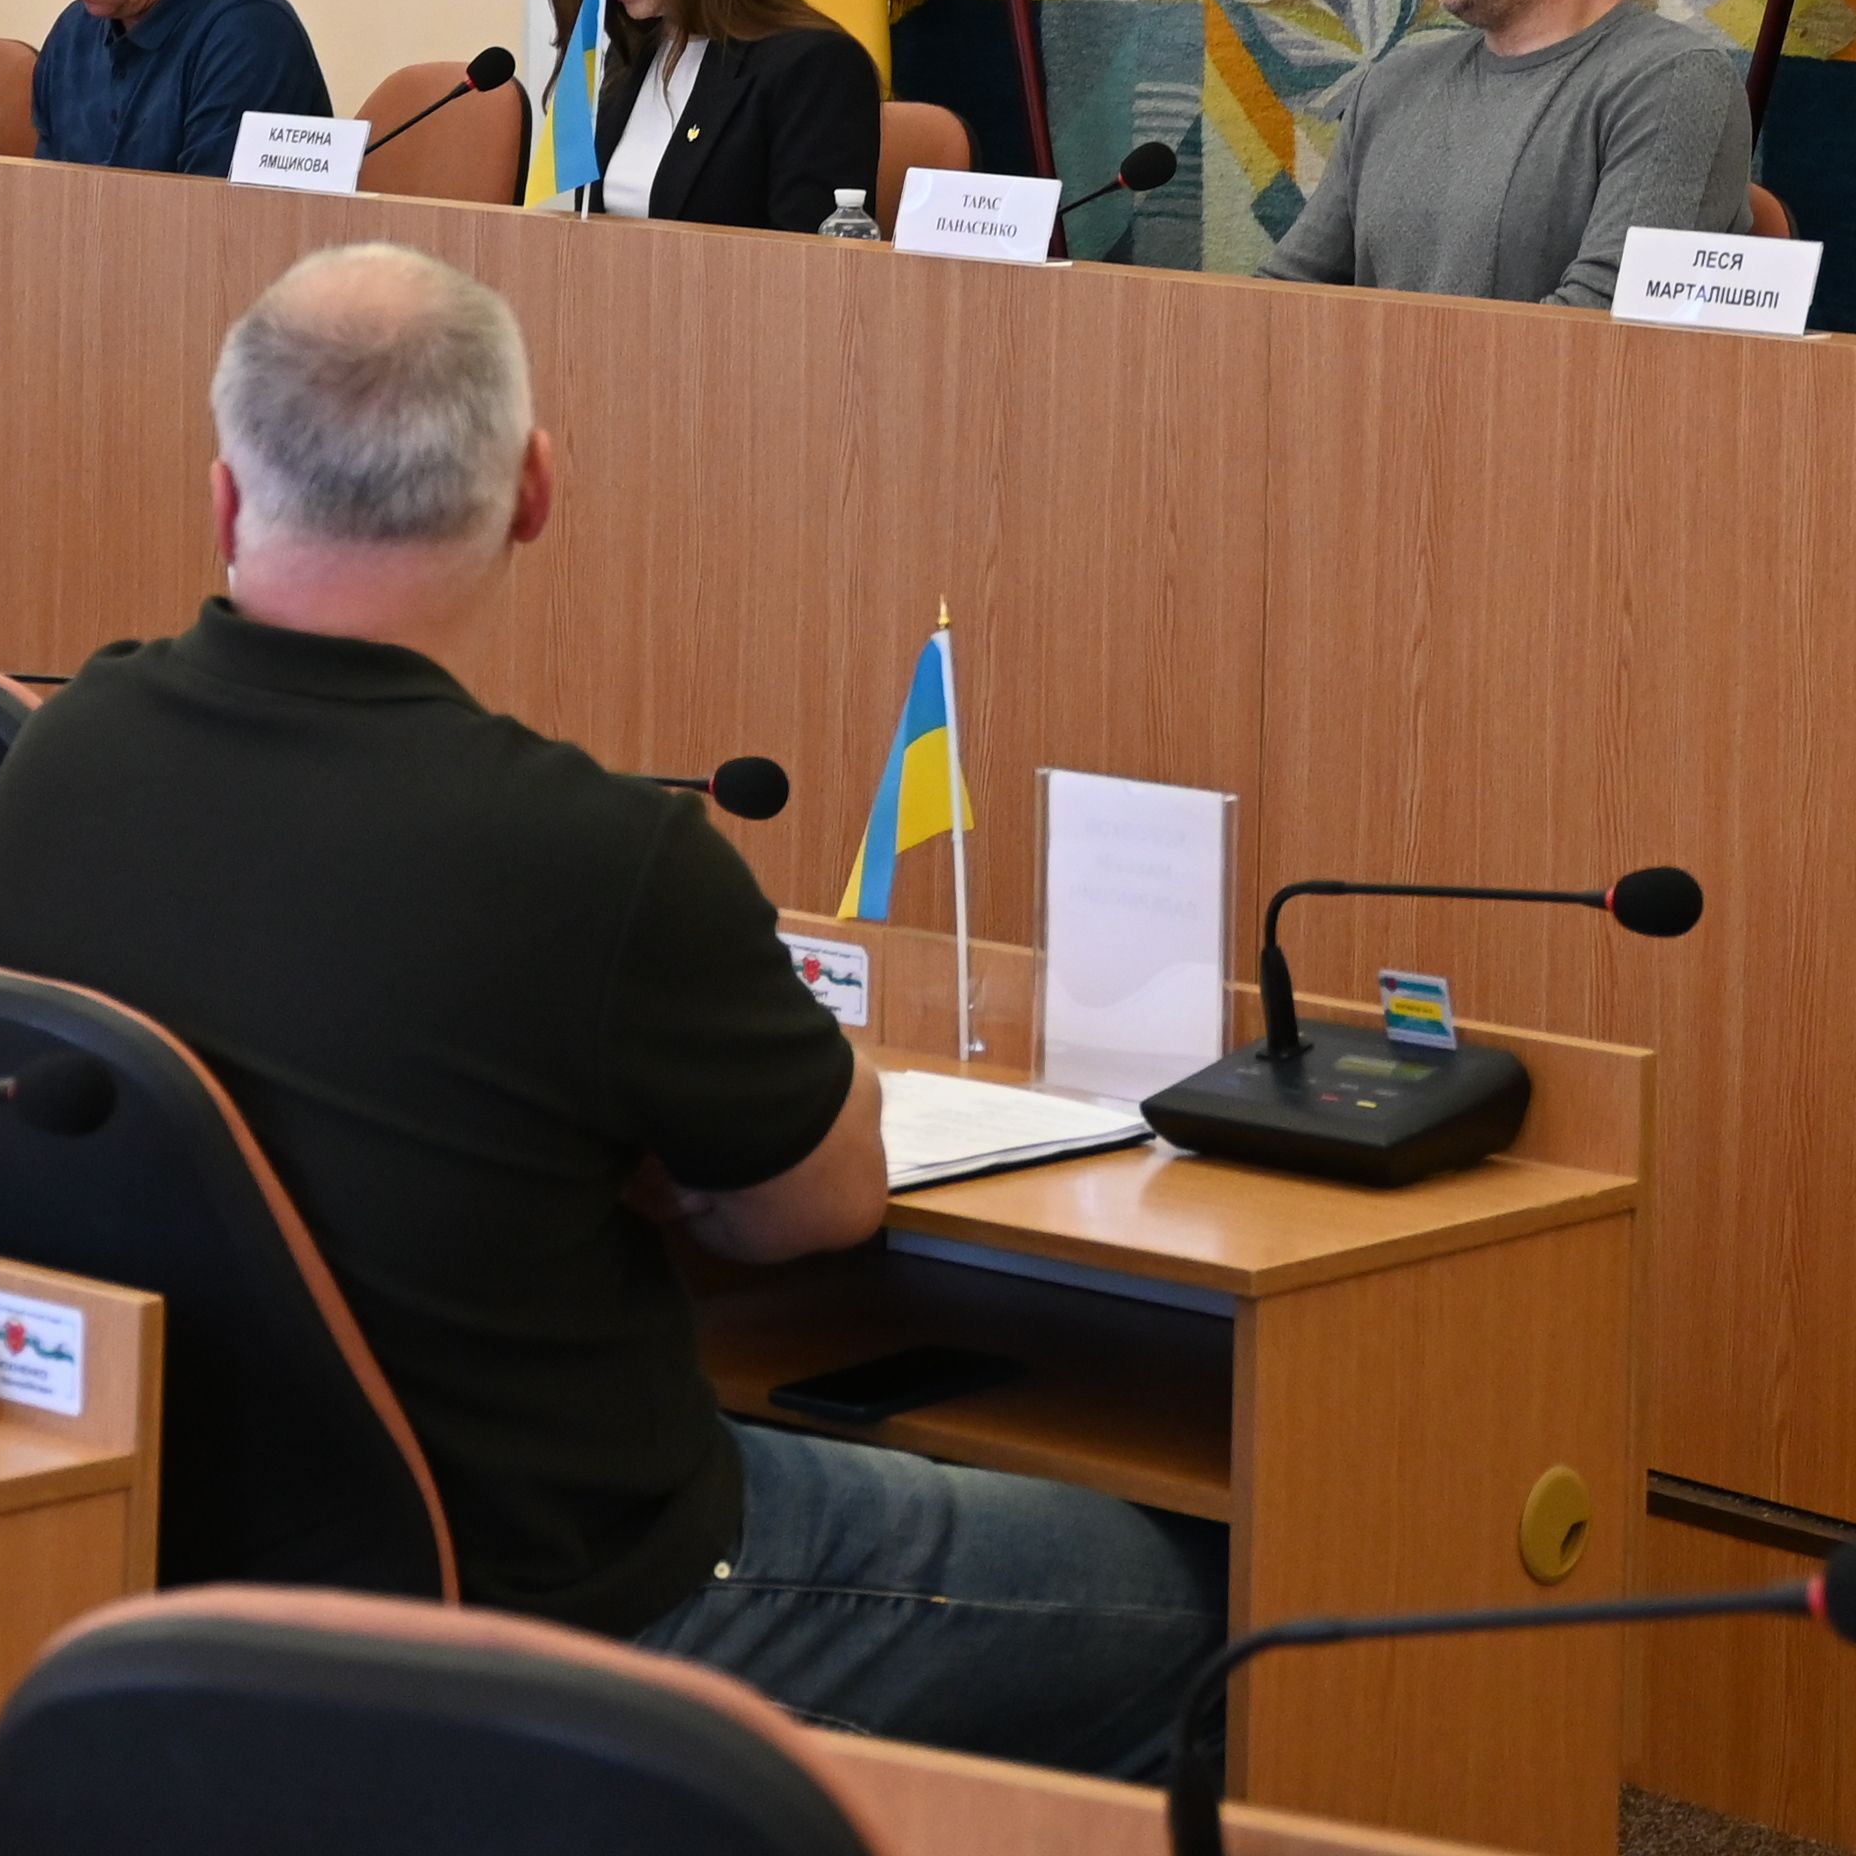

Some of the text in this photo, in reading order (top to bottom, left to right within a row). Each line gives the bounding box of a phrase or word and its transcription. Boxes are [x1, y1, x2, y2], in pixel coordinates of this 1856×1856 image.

[268, 127, 332, 147] КАТЕРИНА
[258, 154, 329, 174] ЯМЩИКОВА
[962, 193, 1003, 212] ТАРАС
[935, 216, 1019, 240] ПАНАСЕНКО
[1692, 249, 1744, 271] ЛЕСЯ
[1645, 279, 1780, 310] МАРТАЛІШВІЛІ
